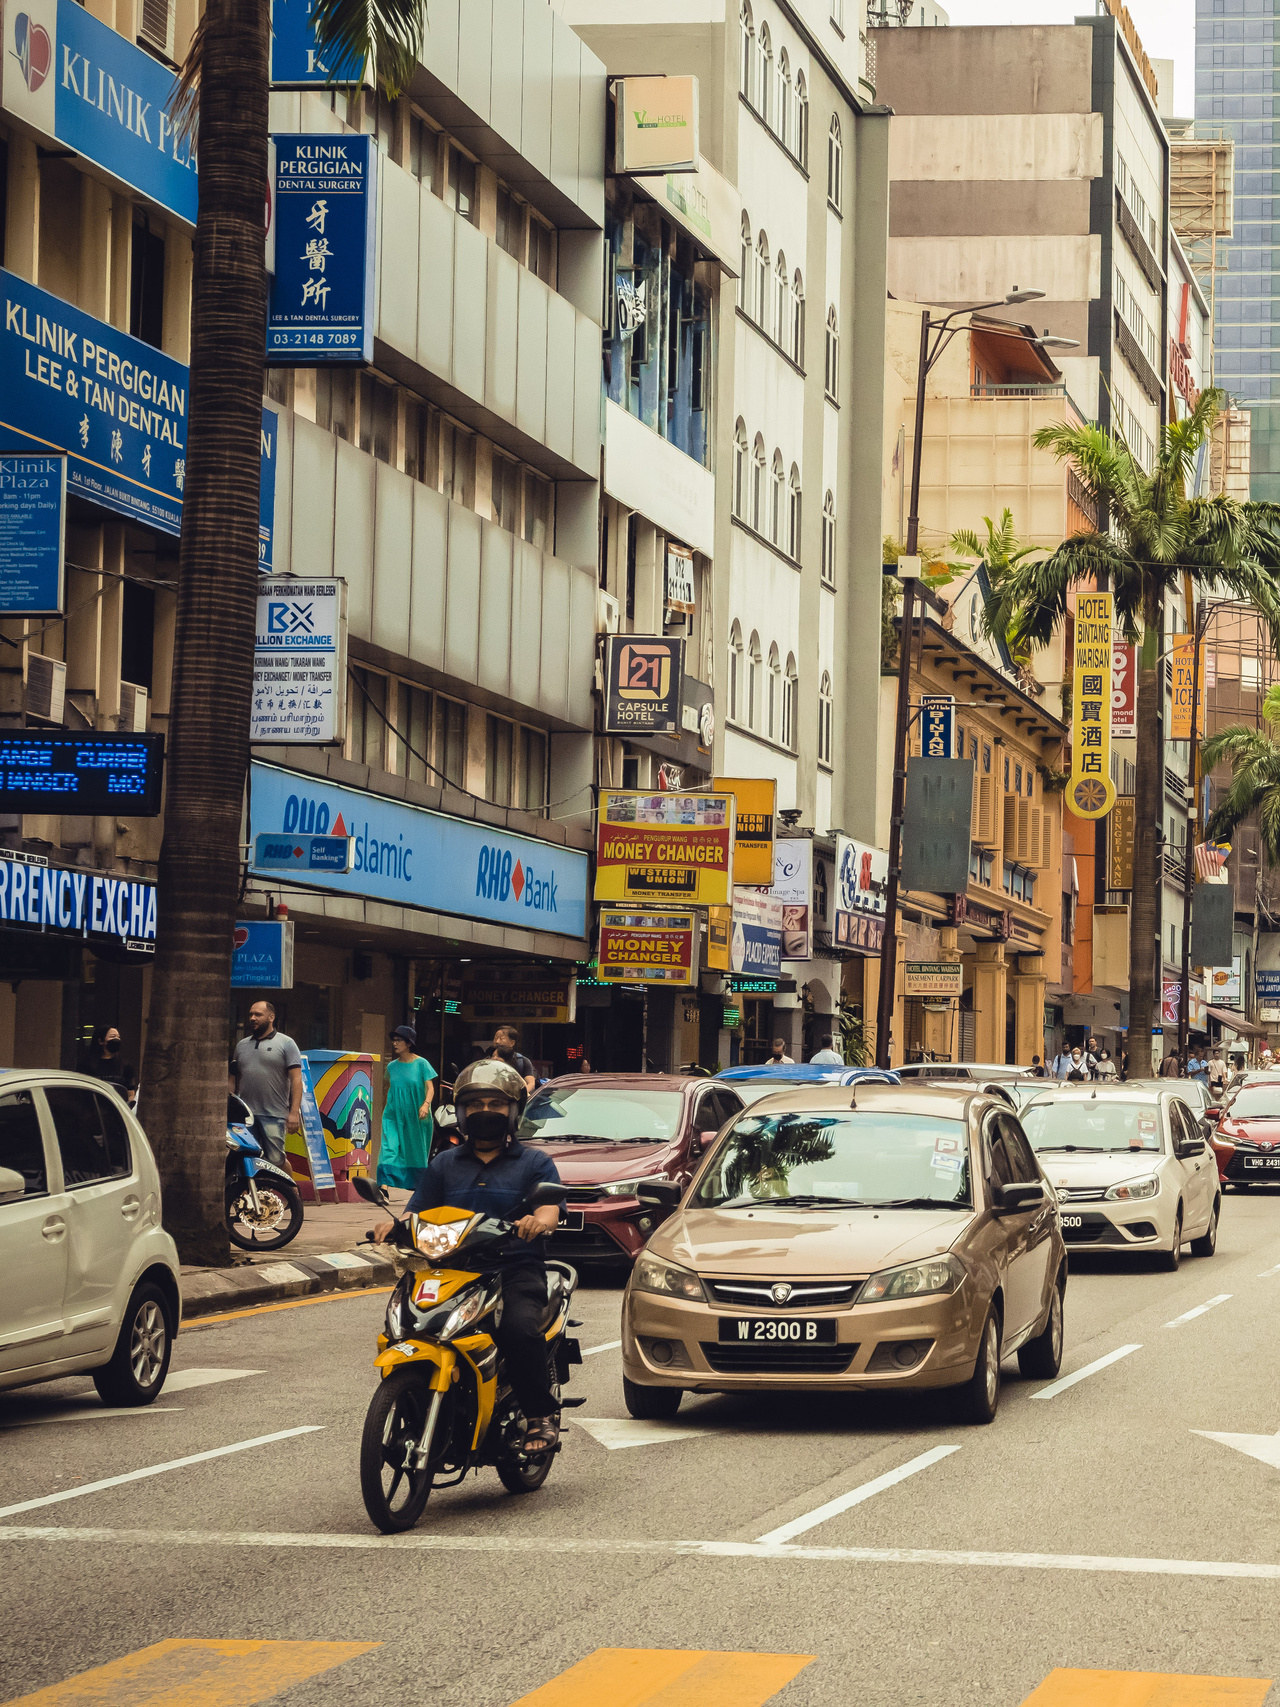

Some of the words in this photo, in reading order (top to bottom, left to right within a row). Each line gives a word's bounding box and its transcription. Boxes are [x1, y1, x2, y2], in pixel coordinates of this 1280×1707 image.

[62, 44, 152, 144] KLINIK
[296, 146, 347, 158] KLINIK
[280, 161, 362, 174] PERGIGIAN
[278, 180, 316, 189] DENTAL
[318, 180, 362, 190] SURGERY
[300, 200, 334, 312] 牙醫所
[274, 334, 324, 344] 03-2148
[328, 334, 357, 344] 7089
[6, 299, 78, 364] KLINIK
[83, 338, 184, 416] PERGIGIAN
[25, 349, 62, 392] LEE
[66, 370, 78, 399] &
[82, 376, 114, 416] TAN
[119, 395, 184, 450] DENTAL
[0, 460, 56, 474] Klinik
[0, 476, 49, 488] Plaza
[1078, 599, 1109, 619] HOTEL
[256, 636, 282, 645] ILLION
[285, 636, 332, 645] EXCHANGE
[1078, 624, 1109, 644] BINTANG
[312, 657, 325, 667] WANG
[1076, 648, 1110, 669] WARISAN
[292, 672, 309, 681] MONEY
[309, 672, 332, 681] TRANSFER
[629, 656, 660, 687] 21
[1112, 652, 1128, 708] OYO
[618, 702, 668, 712] CAPSULE
[618, 712, 654, 720] HOTEL
[1080, 674, 1102, 774] 國寶酒店
[928, 711, 944, 756] BINTANG
[737, 814, 762, 823] TERN
[737, 824, 762, 832] NION
[264, 844, 293, 859] RHB
[604, 842, 653, 860] MONEY
[657, 844, 724, 863] CHANGER
[630, 868, 685, 876] WESTERN
[1114, 856, 1122, 886] WANG
[476, 844, 513, 902] RHB
[524, 866, 558, 912] Bank
[792, 888, 805, 896] Spa
[607, 939, 684, 952] MONEY
[745, 941, 762, 963] PLACID
[237, 954, 273, 962] PLAZA
[608, 951, 682, 963] CHANGER
[231, 974, 271, 982] oor(Tingkat
[468, 990, 506, 1002] MONEY
[511, 991, 564, 1003] CHANGER
[738, 1321, 750, 1340] W
[754, 1321, 800, 1341] 2300
[806, 1322, 817, 1341] B
